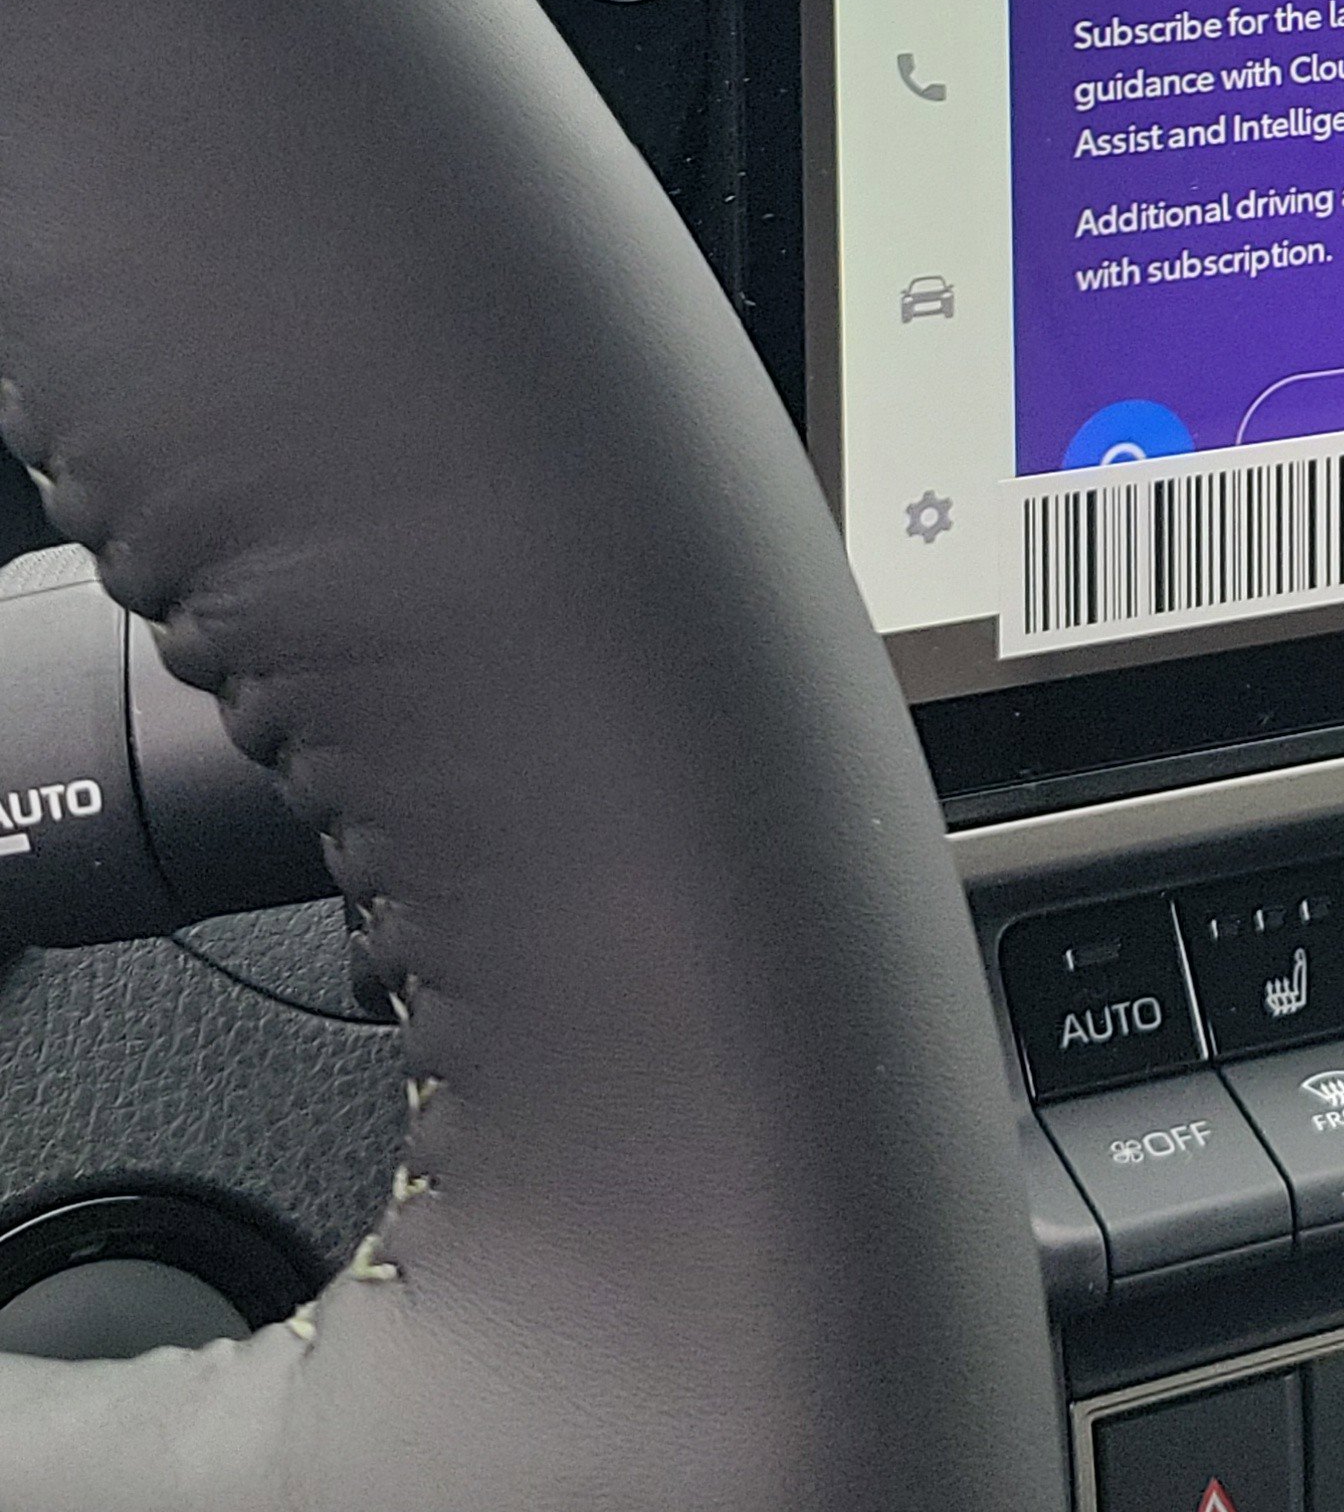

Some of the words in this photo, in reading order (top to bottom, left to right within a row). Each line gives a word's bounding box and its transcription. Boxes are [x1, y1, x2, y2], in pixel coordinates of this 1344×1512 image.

[1073, 6, 1222, 50] Subscribe
[1227, 6, 1267, 38] for
[1275, 1, 1323, 33] the
[1073, 65, 1216, 111] guidance
[1220, 57, 1283, 91] with
[1073, 113, 1165, 159] Assist
[1167, 108, 1226, 147] and
[1074, 198, 1231, 239] Additional
[1236, 184, 1335, 223] driving
[1075, 254, 1142, 291] with
[1146, 238, 1333, 285] subscription.
[1060, 995, 1163, 1050] AUTO
[1143, 1121, 1212, 1158] OFF
